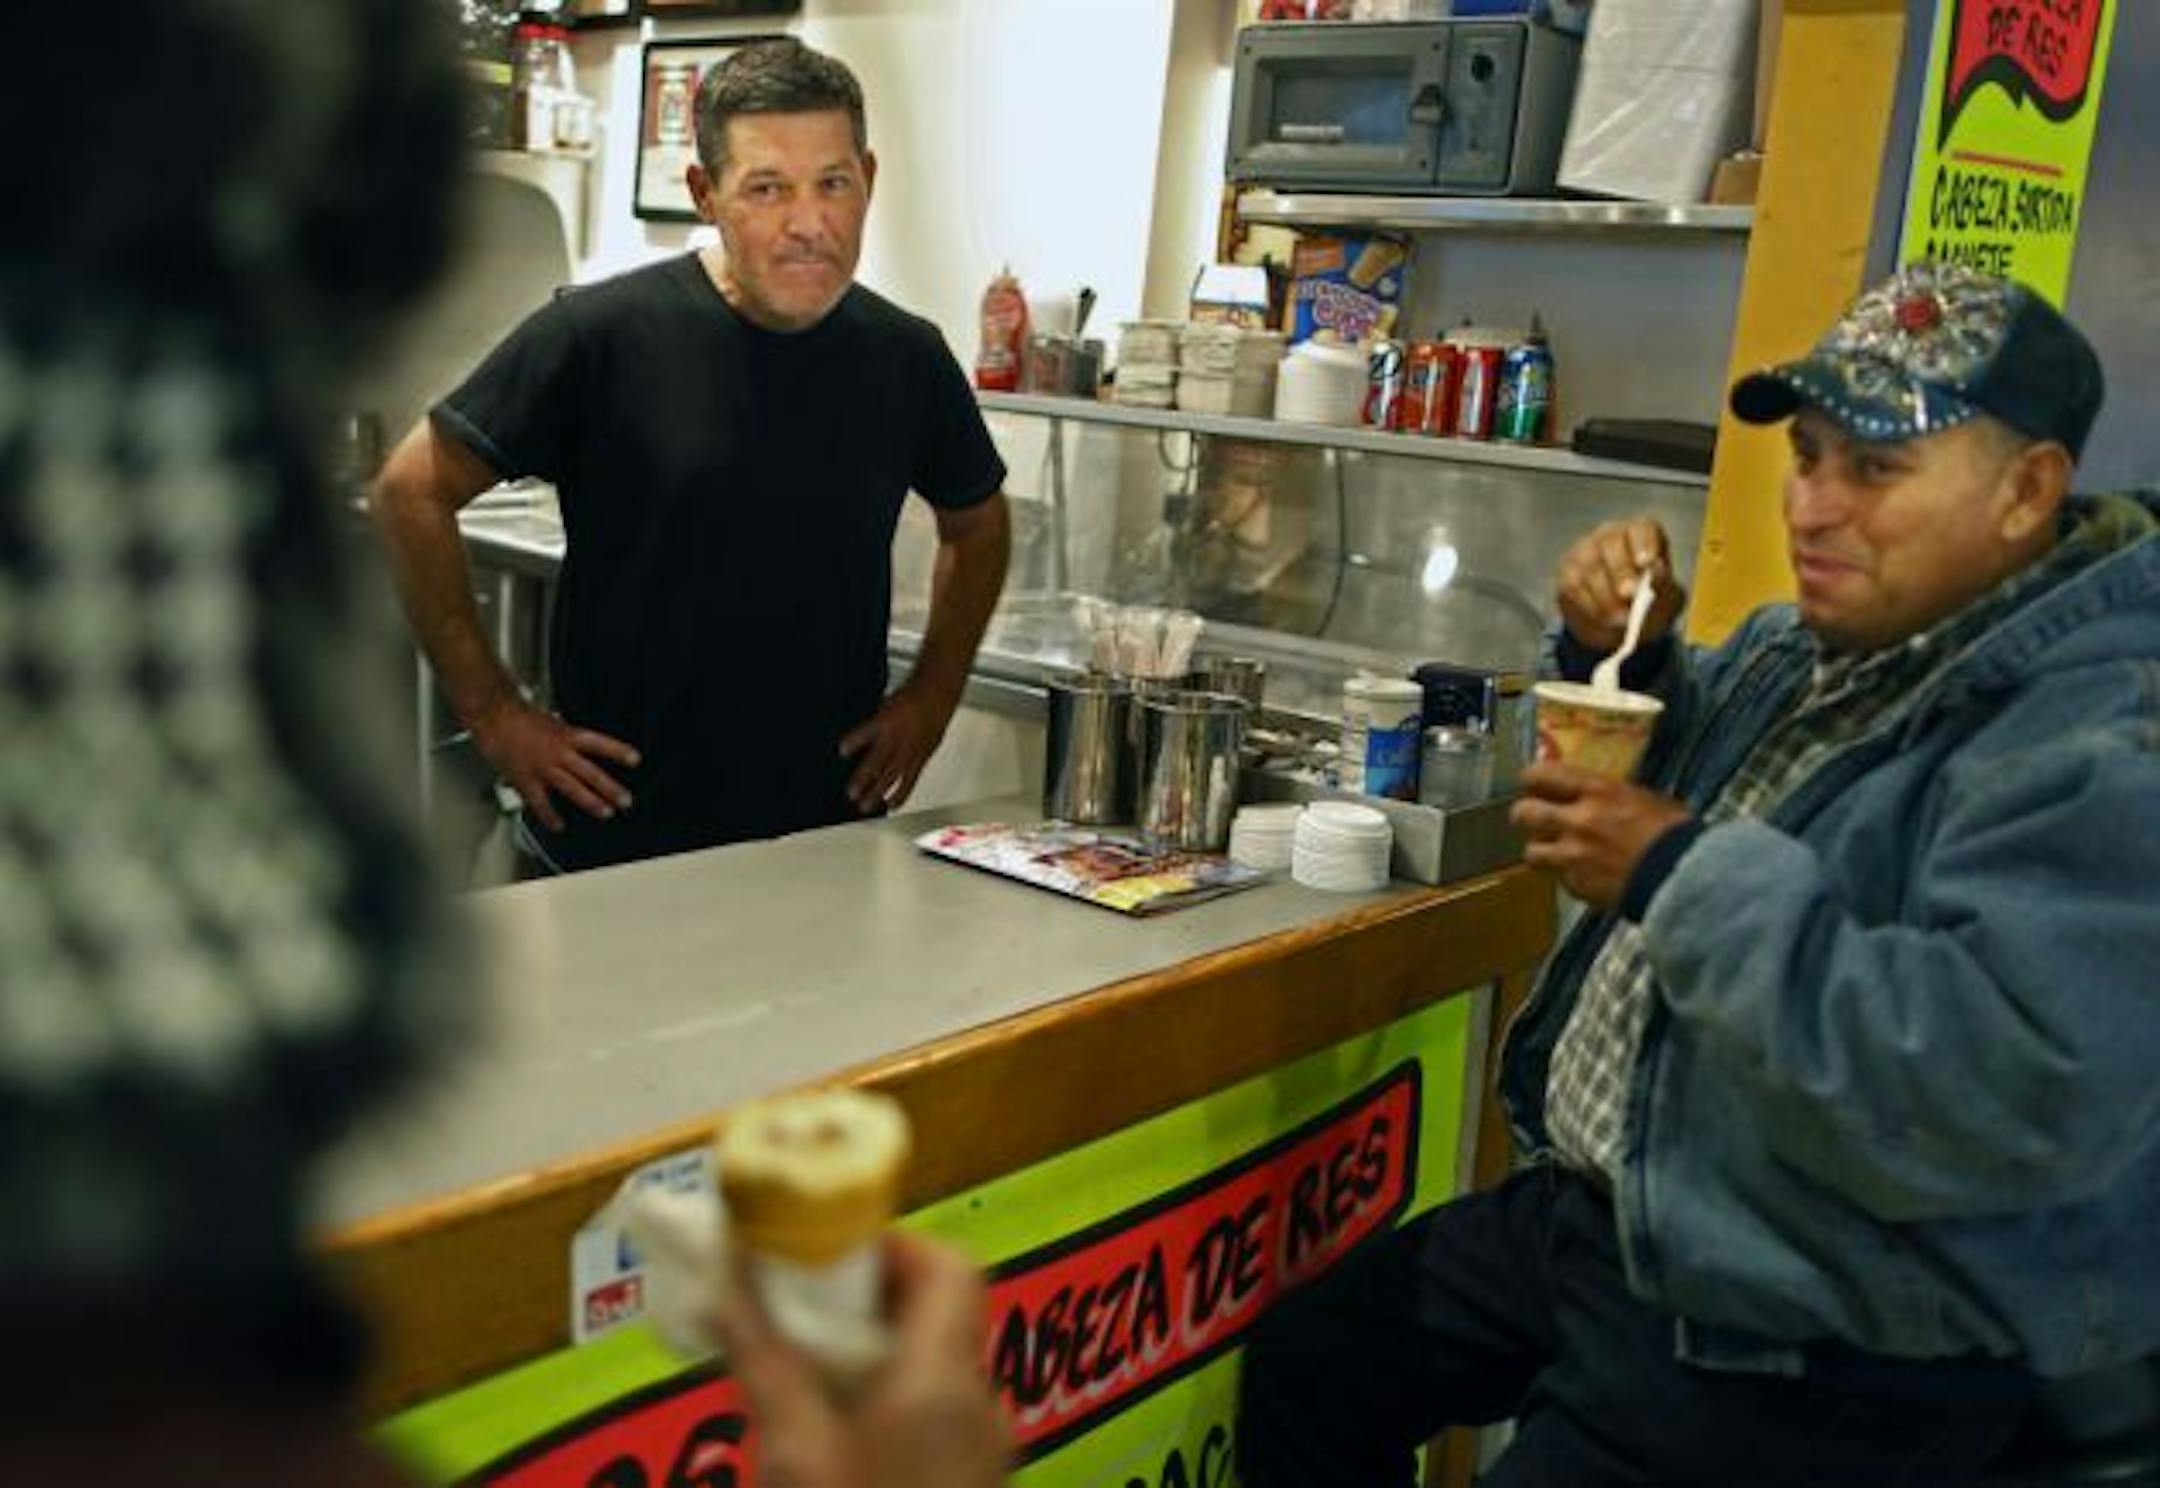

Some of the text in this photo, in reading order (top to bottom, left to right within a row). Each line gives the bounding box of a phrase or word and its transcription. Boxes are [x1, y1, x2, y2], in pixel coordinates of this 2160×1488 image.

[992, 1113, 1389, 1406] ABEZA DE RES
